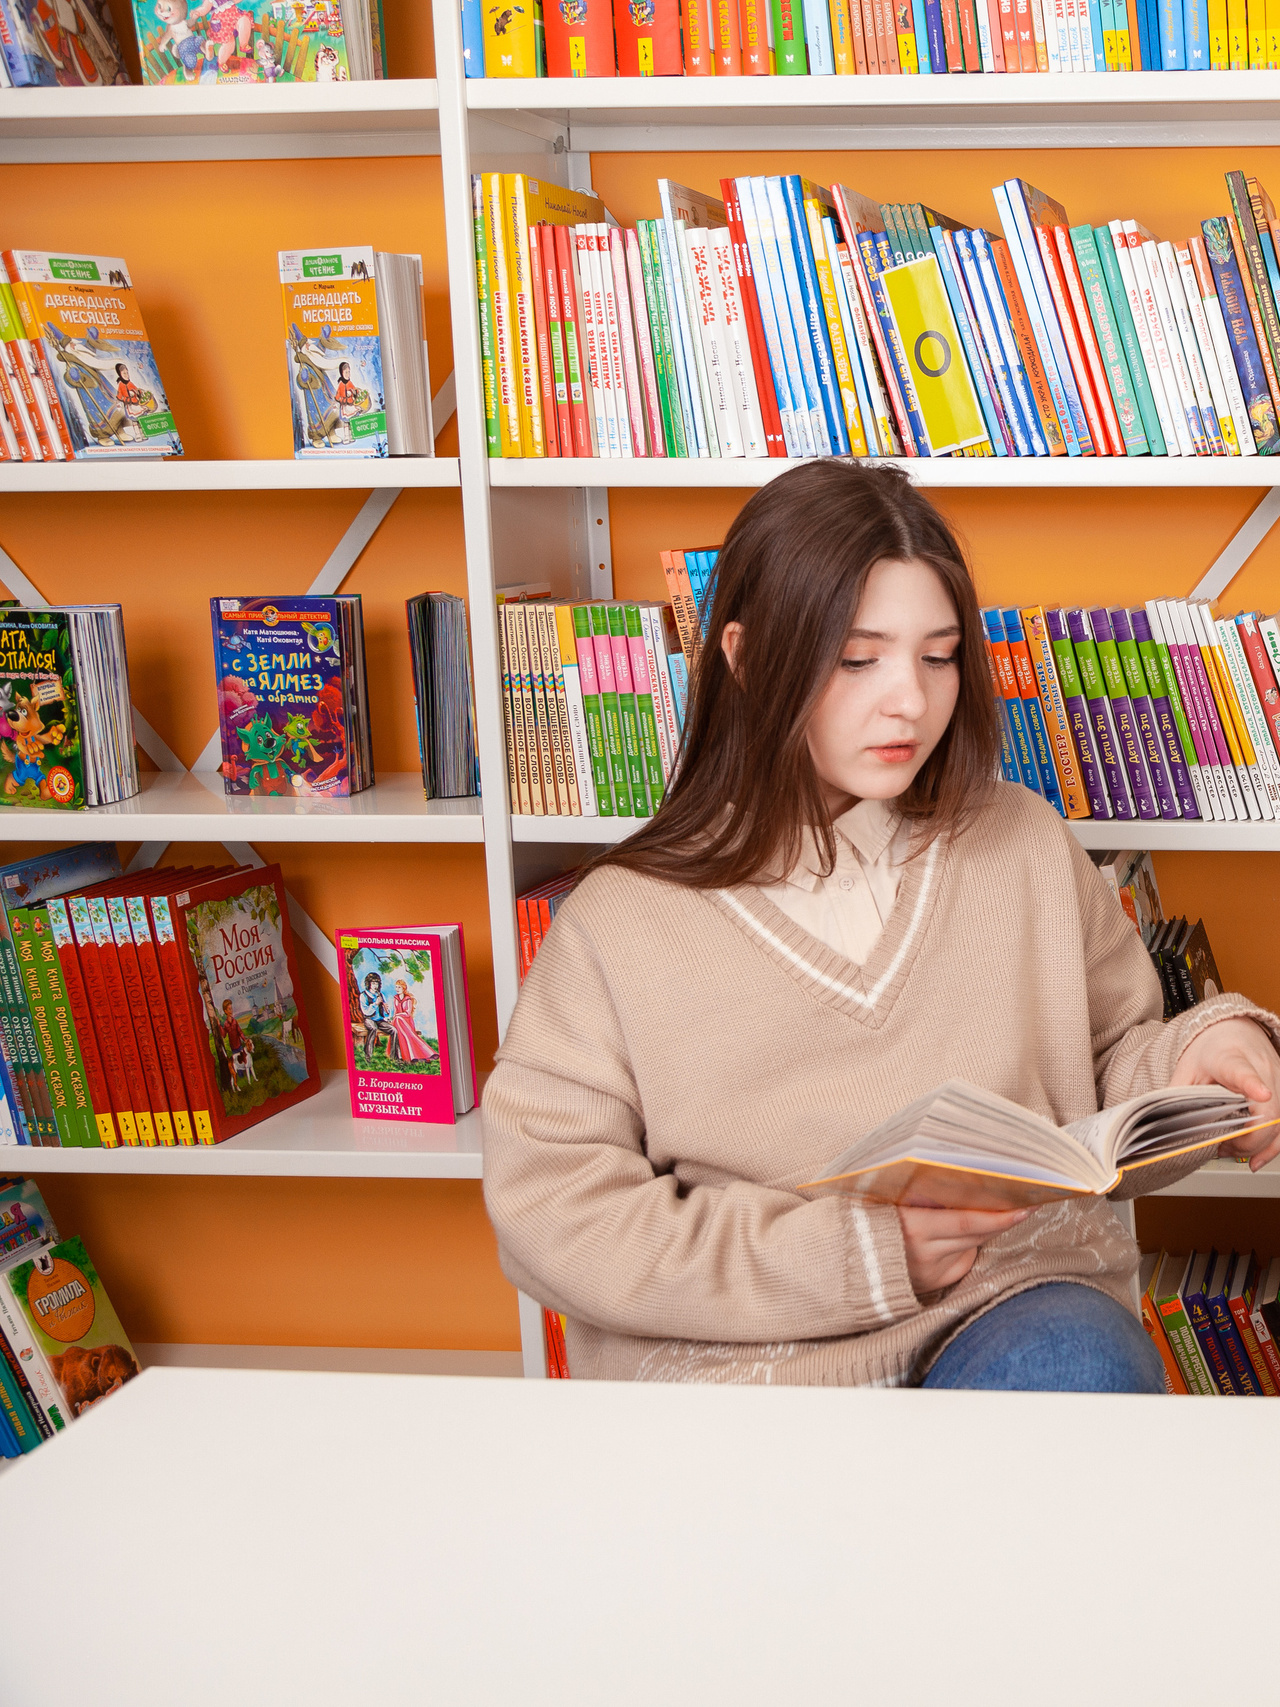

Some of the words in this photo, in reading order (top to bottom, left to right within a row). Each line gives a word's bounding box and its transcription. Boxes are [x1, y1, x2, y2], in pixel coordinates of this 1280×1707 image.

[60, 269, 92, 279] ЧТЕНИЕ
[309, 265, 336, 276] ЧТЕНИЕ
[45, 294, 126, 310] ДВЕНАДЦАТЬ
[293, 291, 362, 309] ДВЕНАДЦАТЬ
[60, 310, 120, 326] МЕСЯЦЕВ
[303, 308, 353, 324] МЕСЯЦЕВ
[0, 650, 57, 671] ОПАЛСЯ!
[246, 652, 312, 672] ЗЕМЛИ
[1040, 640, 1055, 681] СОВЕТЫ
[242, 677, 257, 687] на
[258, 672, 325, 692] ЯЛМЕЗ
[1036, 661, 1053, 713] САМЫЕ
[256, 693, 265, 702] и
[268, 690, 320, 706] обратно
[1051, 682, 1067, 731] ВРЕДНЫЕ
[1073, 712, 1084, 731] Эти
[558, 698, 572, 753] ВОЛШЕБНОЕ
[565, 754, 575, 785] СЛОВО
[1080, 740, 1093, 764] Дети
[395, 938, 430, 947] КЛАССИКА
[21, 1016, 39, 1064] МОРОЗКО
[370, 1078, 424, 1091] Короленко
[357, 1090, 404, 1103] СЛЕПОЙ
[359, 1103, 423, 1116] МУЗЫКАНТ
[34, 1280, 87, 1317] ГРОМИЛА
